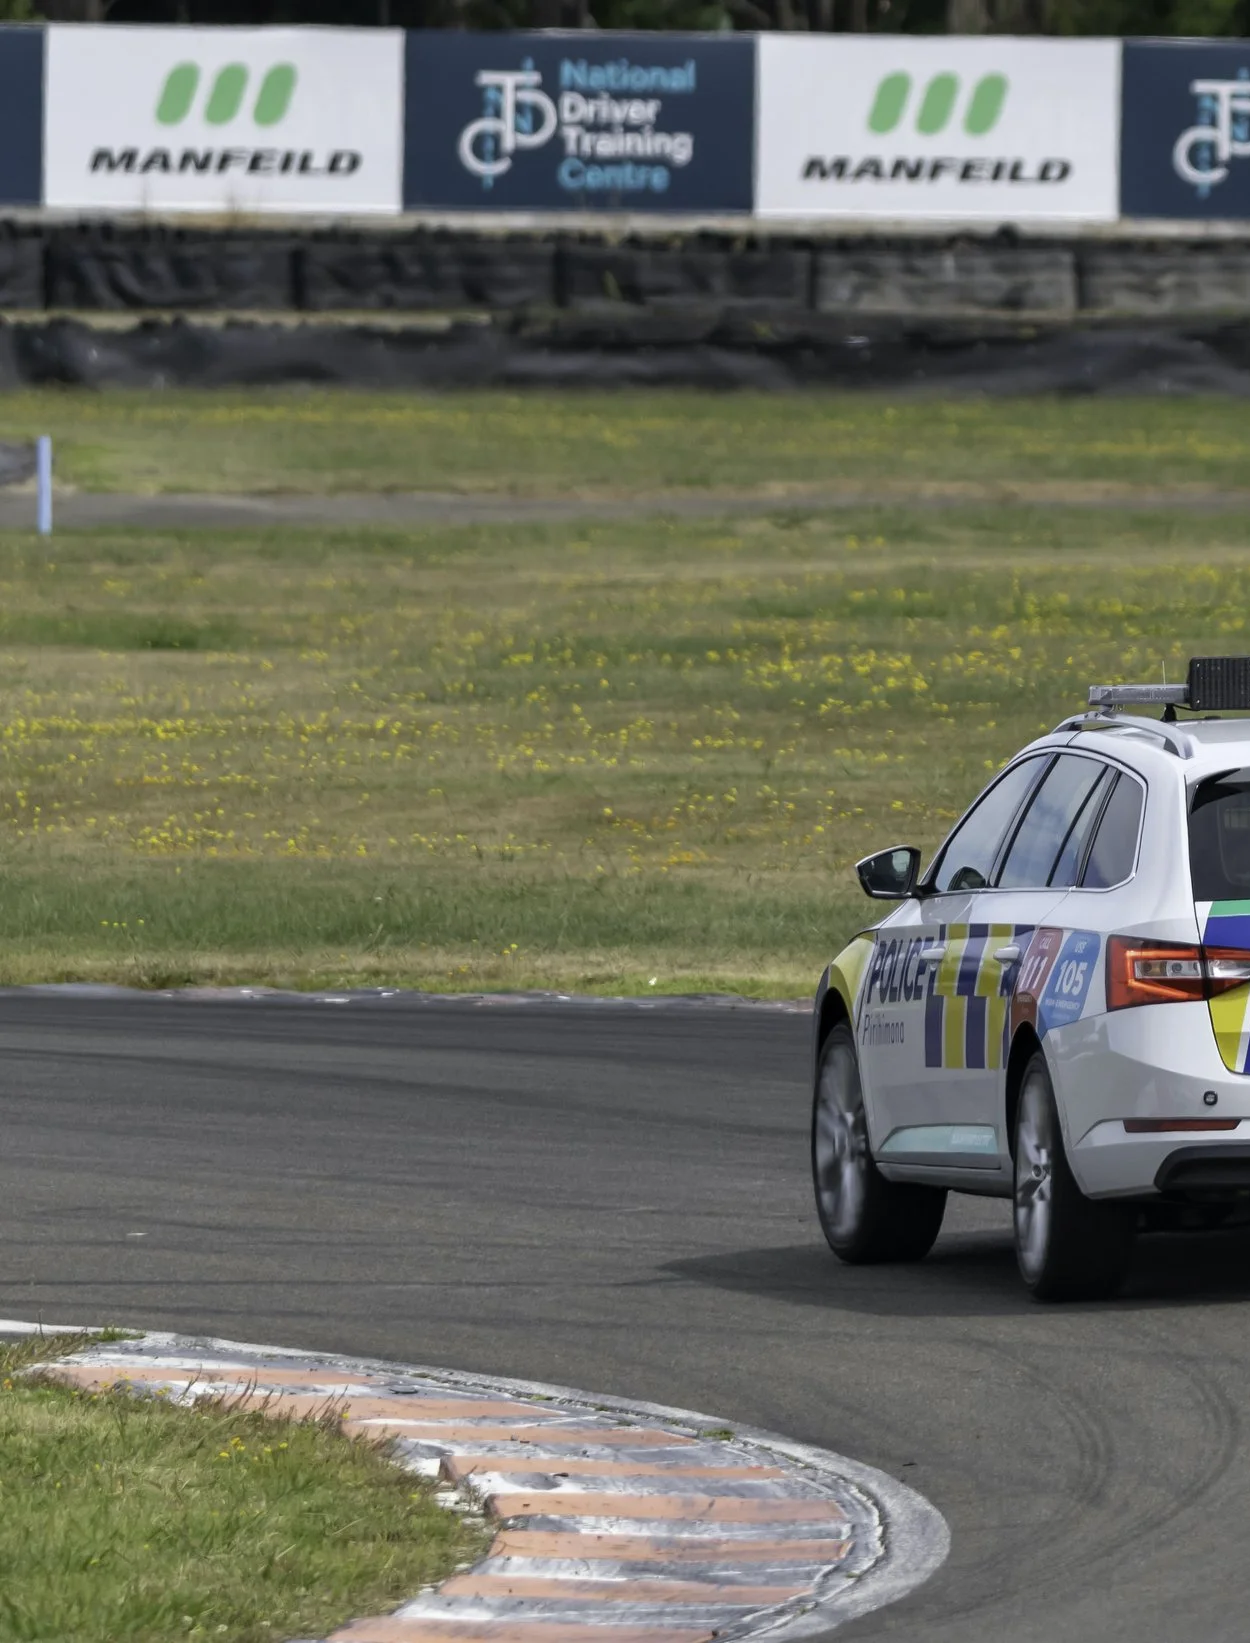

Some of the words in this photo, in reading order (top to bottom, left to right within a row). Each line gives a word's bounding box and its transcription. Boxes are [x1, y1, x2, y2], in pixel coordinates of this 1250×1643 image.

[560, 58, 696, 91] National
[560, 91, 661, 124] Driver
[90, 147, 363, 177] MANFEILD
[560, 124, 693, 167] Training
[558, 157, 669, 191] Centre
[802, 155, 1073, 185] MANFEILD
[867, 936, 935, 1004] POLICE
[1019, 956, 1049, 989] 111
[1054, 959, 1088, 996] 105
